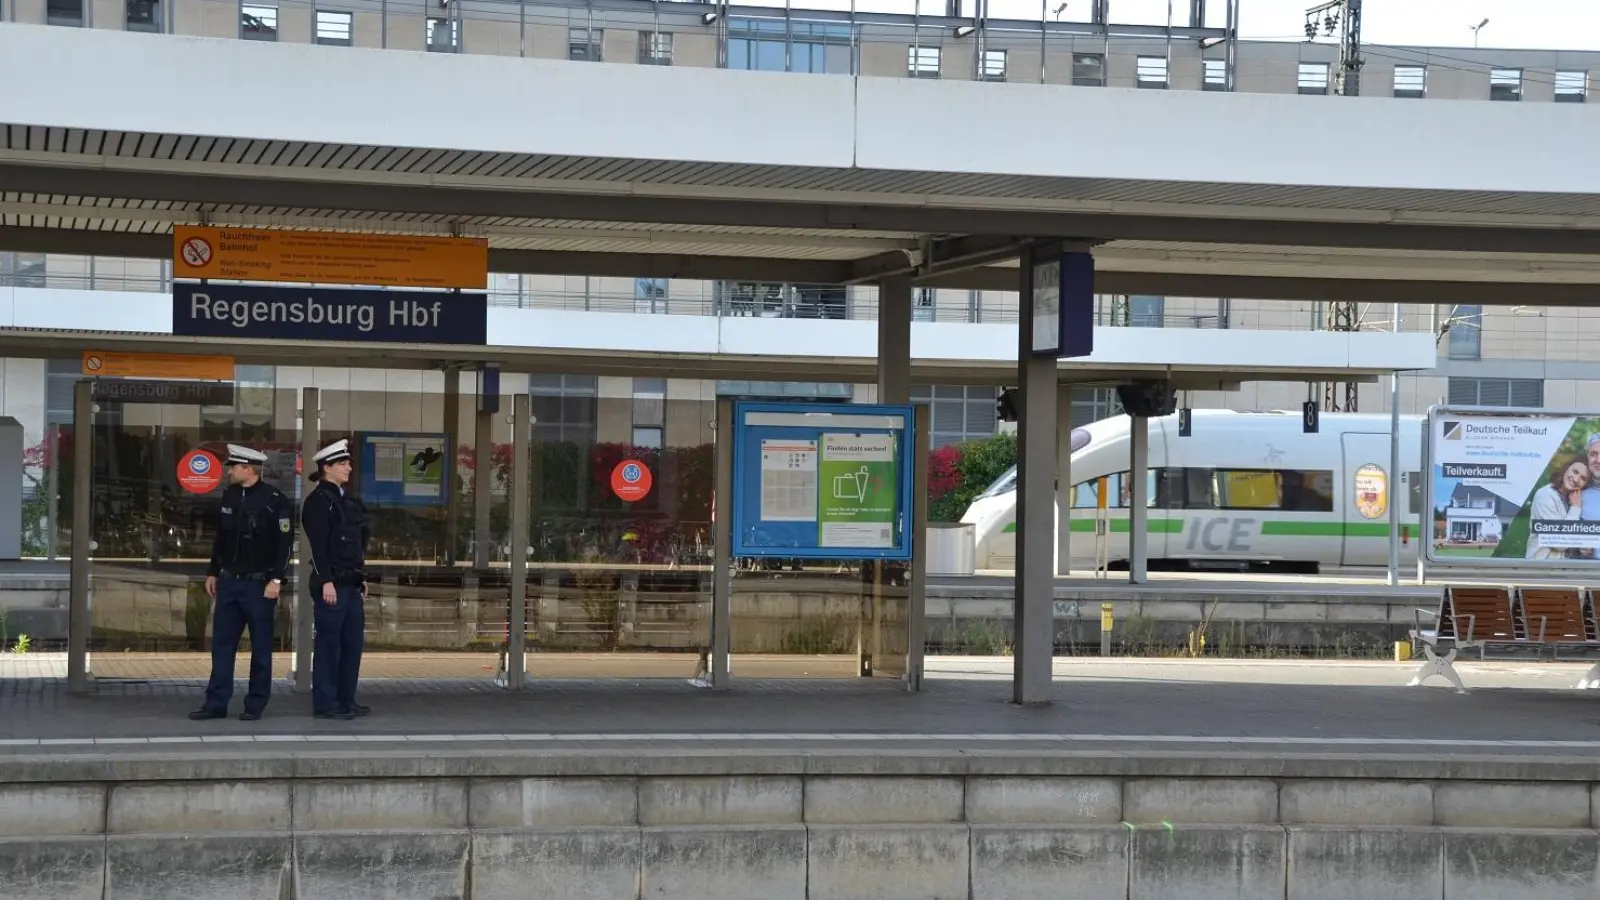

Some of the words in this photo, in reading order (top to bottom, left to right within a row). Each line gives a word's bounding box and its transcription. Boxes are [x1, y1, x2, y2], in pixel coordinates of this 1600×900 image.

[220, 231, 271, 241] Rauchfreier
[220, 242, 258, 252] Bahnhof
[220, 259, 272, 269] Non-Smoking
[220, 268, 248, 276] Station
[191, 292, 374, 332] Regensburg
[389, 300, 441, 327] Hbf
[91, 382, 178, 398] Regensburg
[186, 384, 212, 398] Hbf
[1180, 409, 1185, 431] 9
[1307, 402, 1314, 426] 8
[1466, 424, 1510, 434] Deutsche
[1513, 425, 1548, 436] Teilkauf
[1445, 465, 1504, 477] Teilverkauft.
[1534, 522, 1560, 532] Ganz
[1186, 517, 1256, 551] ICE
